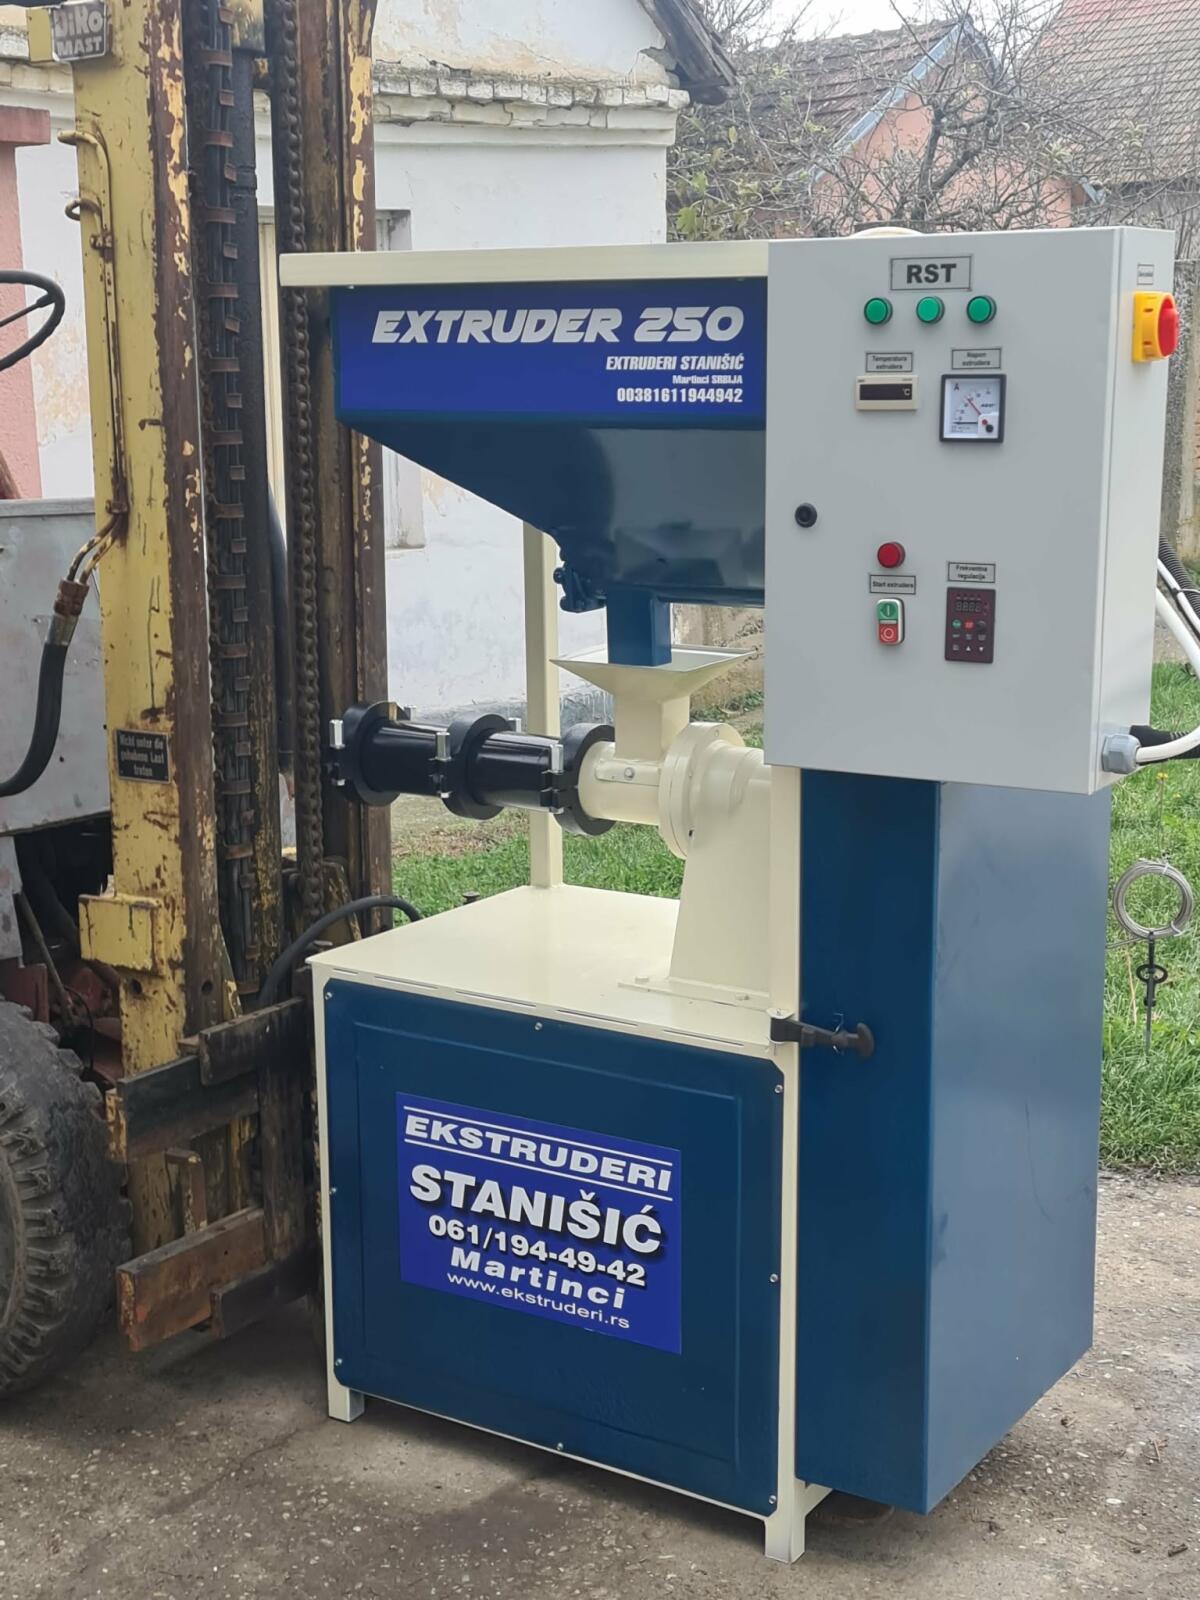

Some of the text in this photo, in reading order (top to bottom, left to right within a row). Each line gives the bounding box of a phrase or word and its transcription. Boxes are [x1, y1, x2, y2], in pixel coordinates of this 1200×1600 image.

[56, 36, 102, 56] MAST
[906, 263, 957, 284] RST
[372, 306, 744, 344] EXTRUDER 250
[605, 353, 745, 370] EXTRUDERI STANIŠIĆ
[872, 355, 908, 364] Temperatura
[672, 374, 743, 384] Martinci SRBIJA
[617, 387, 744, 402] 00381611944942
[872, 580, 887, 588] Start
[405, 1114, 673, 1192] EKSTRUDERI
[409, 1164, 662, 1254] STANIŠIĆ
[428, 1214, 646, 1287] 061/194-49-42
[450, 1246, 625, 1310] Martinci
[447, 1272, 630, 1329] www.ekstruderi.rs
